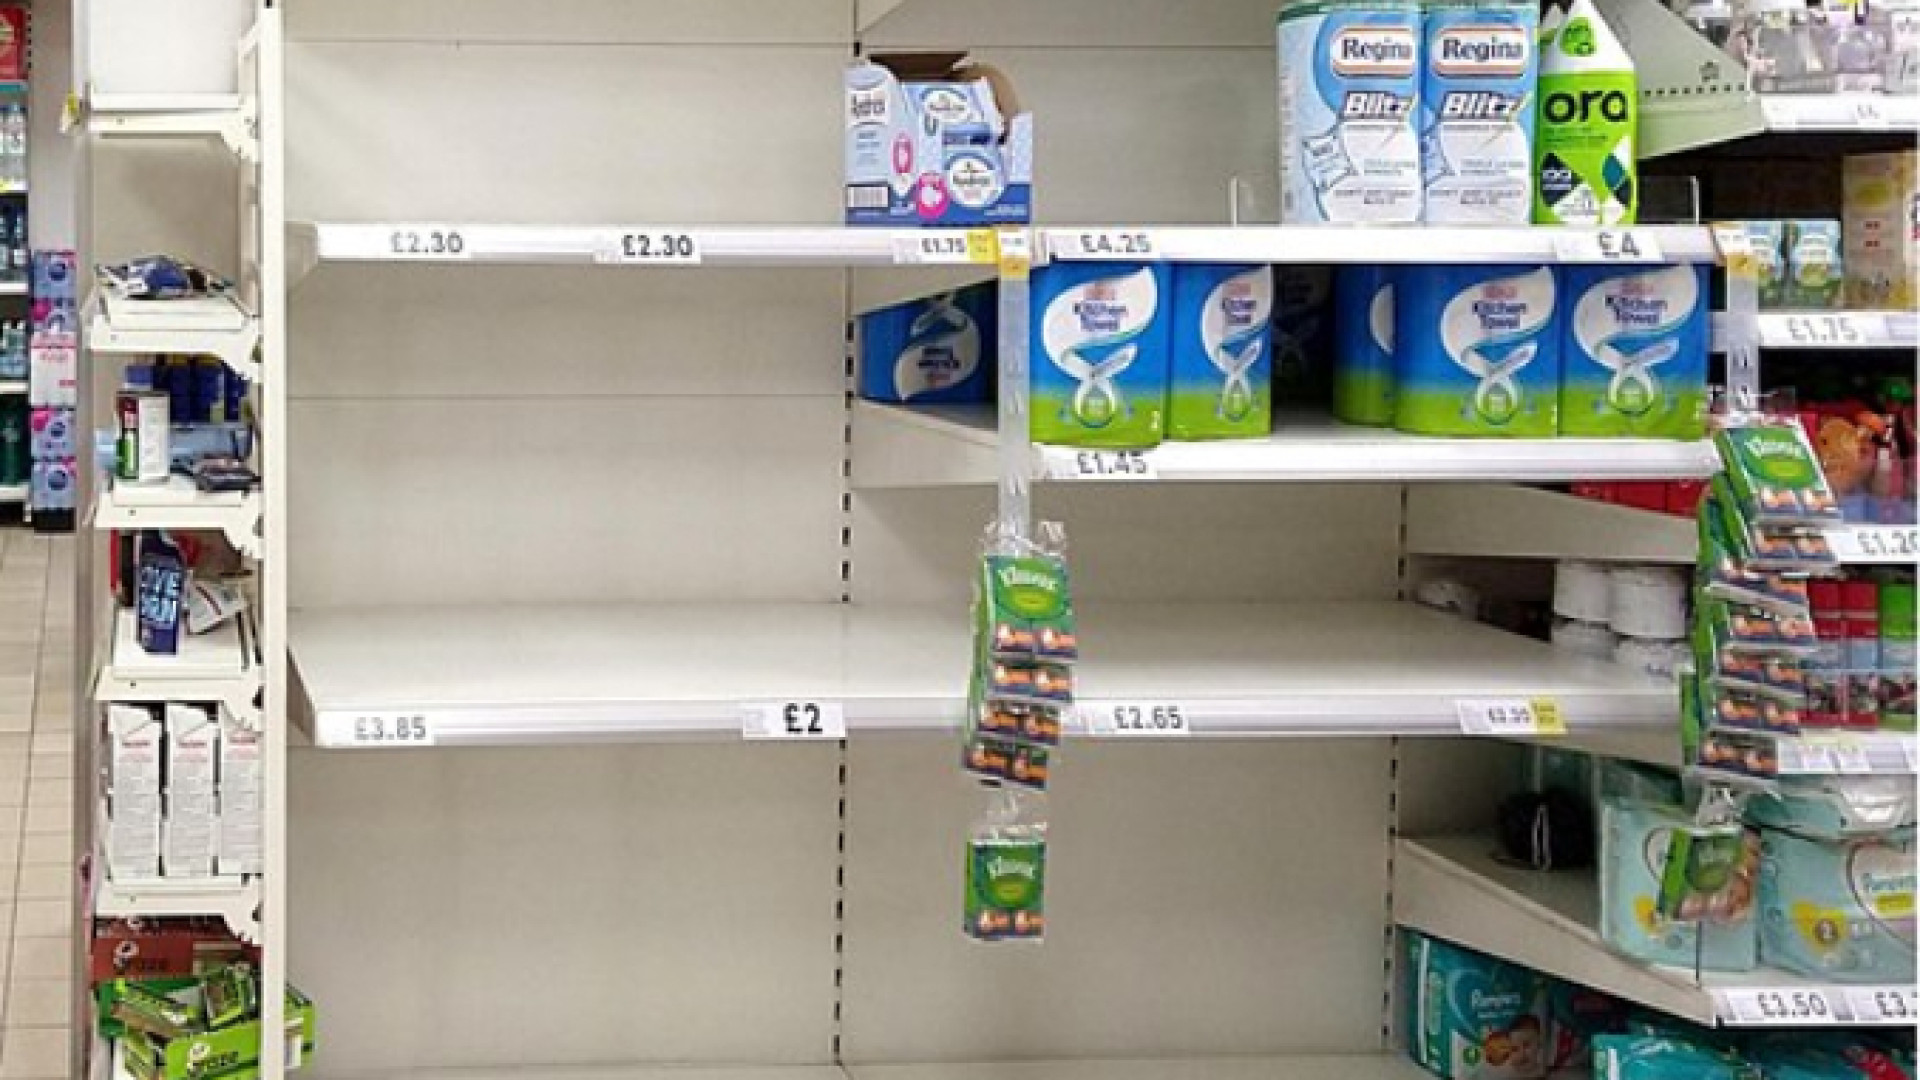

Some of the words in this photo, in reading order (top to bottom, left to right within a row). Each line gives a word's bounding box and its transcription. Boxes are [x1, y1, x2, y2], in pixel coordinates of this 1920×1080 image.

[1342, 36, 1414, 63] Regina
[1441, 35, 1523, 63] Regina
[1344, 91, 1409, 119] Blitz
[1440, 91, 1517, 119] Blitz
[1545, 90, 1629, 123] ora
[391, 231, 465, 253] £2.30
[621, 234, 694, 257] £2.30
[1080, 234, 1152, 254] £4.25
[1599, 232, 1640, 258] £4
[1785, 317, 1858, 341] £1.75
[1078, 451, 1147, 474] £1.45
[355, 714, 427, 740] £3.85
[783, 702, 823, 734] £2
[1114, 705, 1182, 729] £2.65
[1757, 991, 1828, 1017] £3.50
